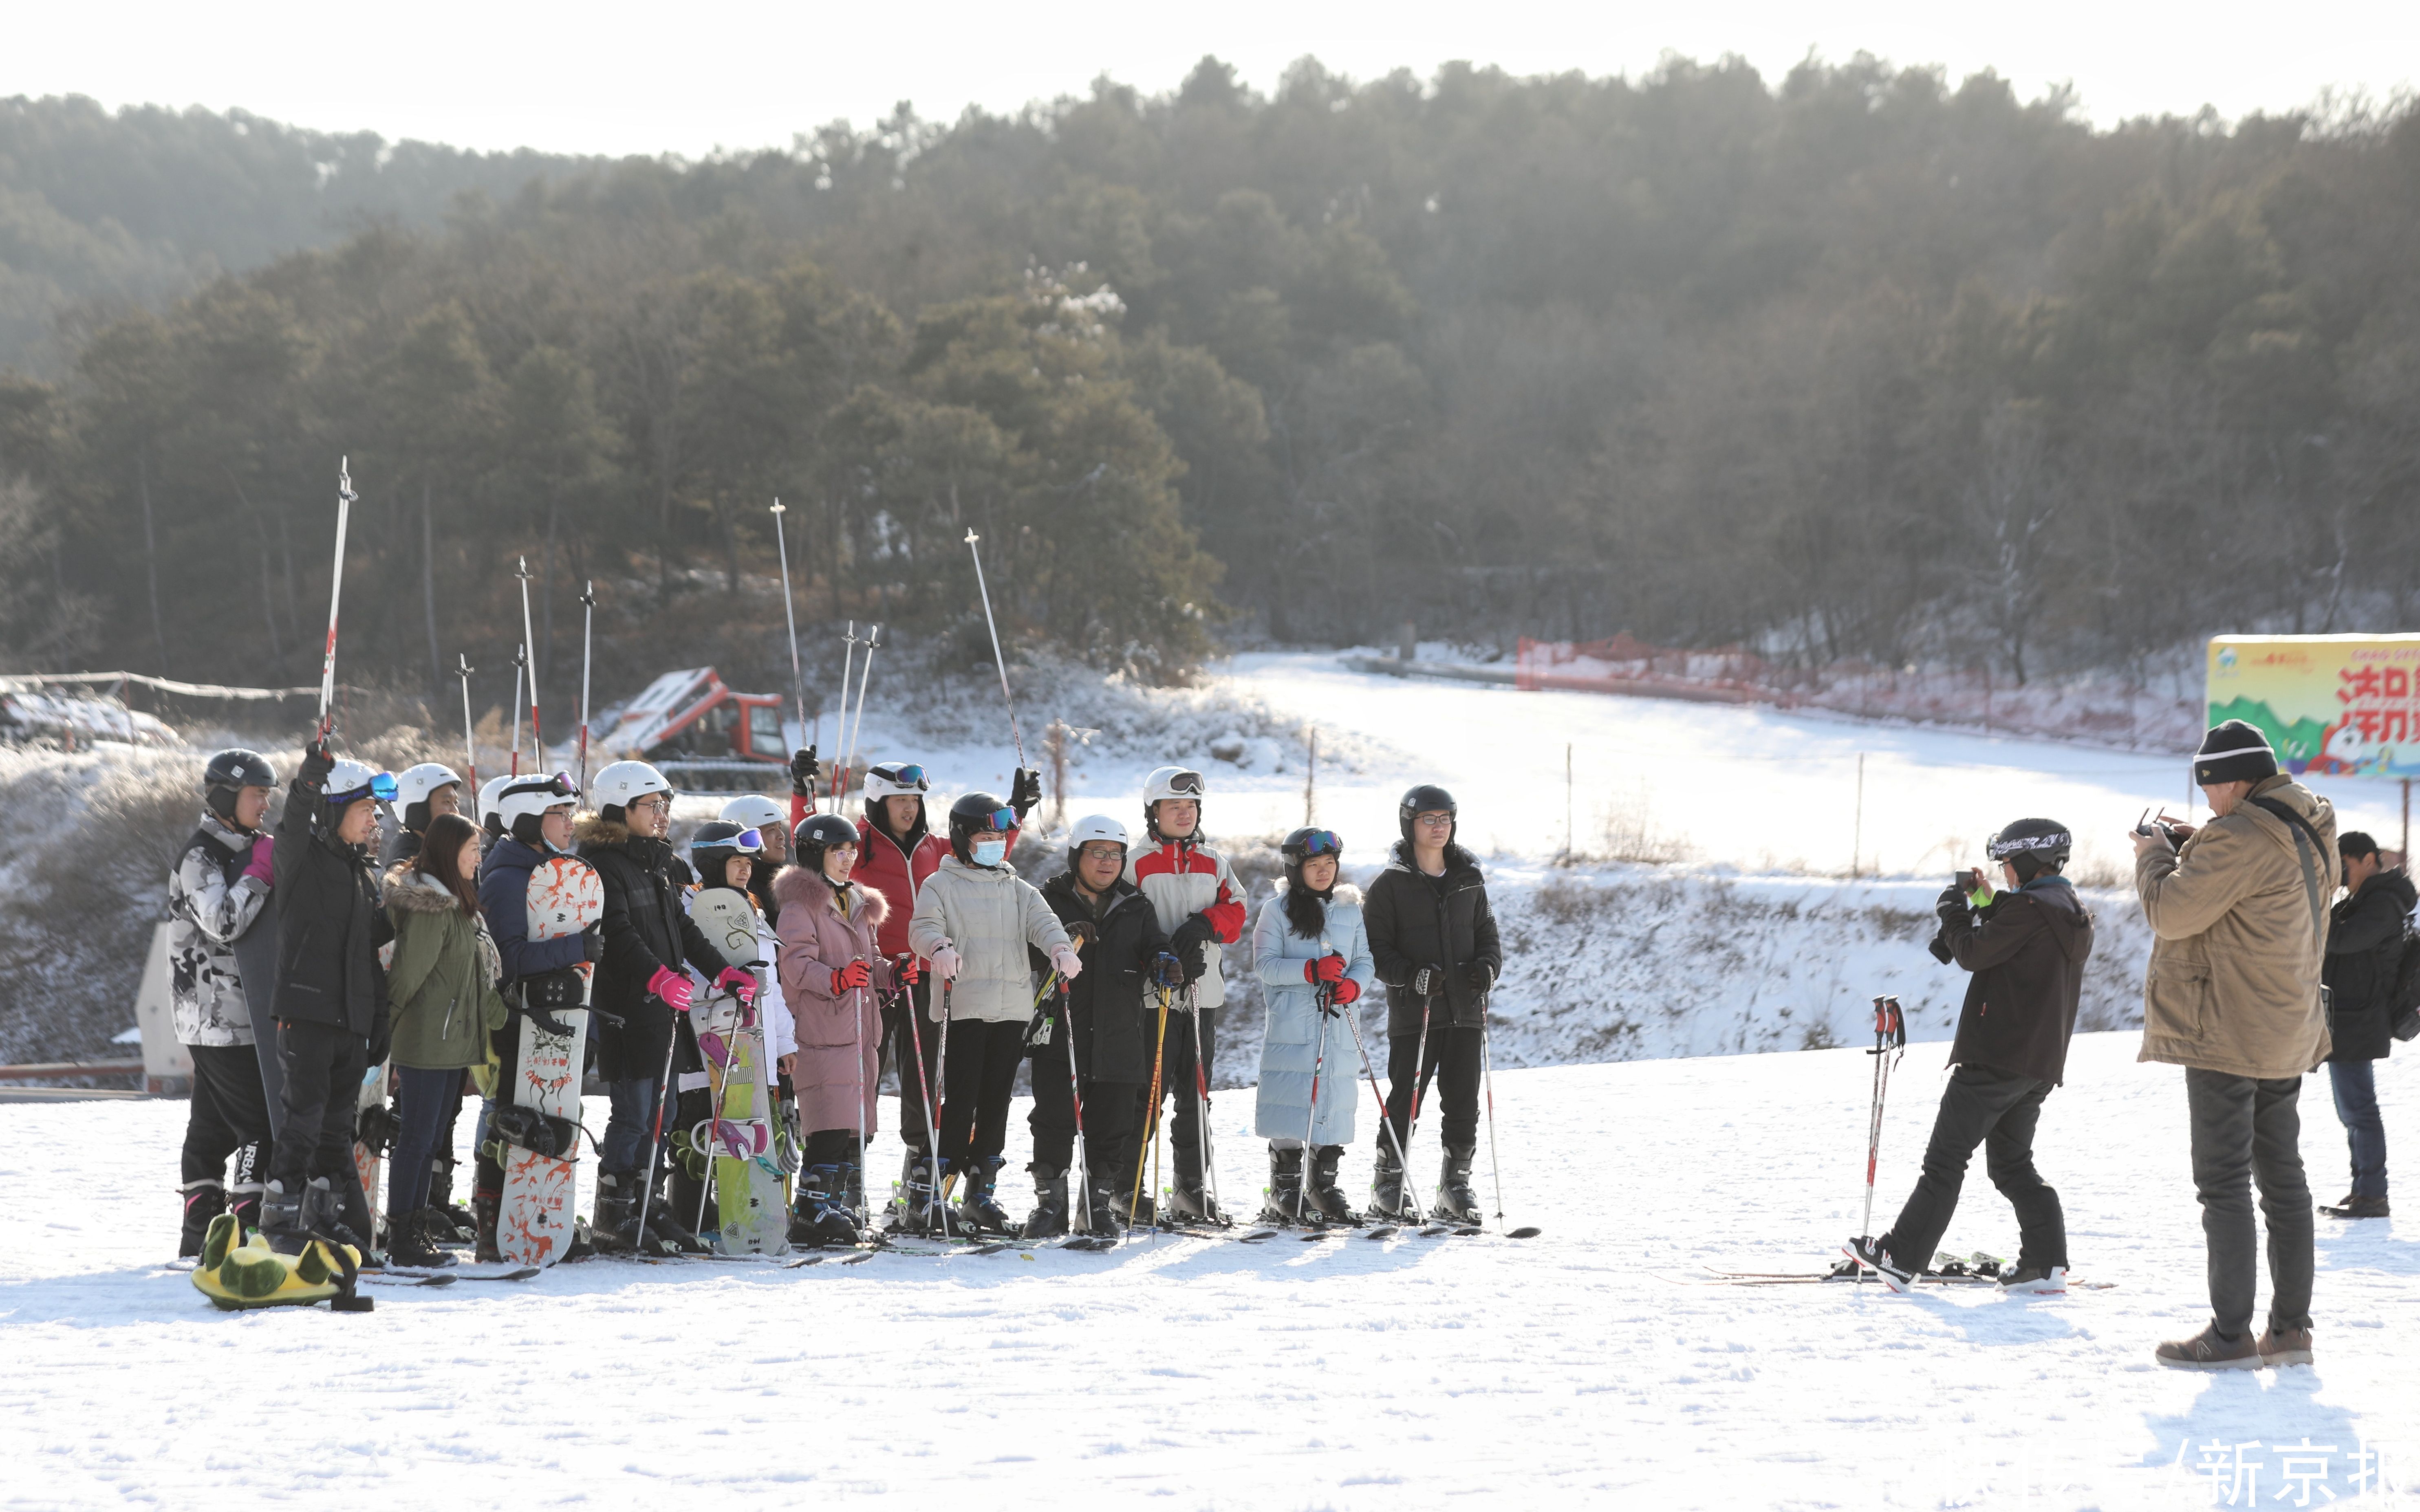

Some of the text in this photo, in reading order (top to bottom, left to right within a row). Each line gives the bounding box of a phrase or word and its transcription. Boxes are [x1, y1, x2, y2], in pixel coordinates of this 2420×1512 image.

[728, 1017, 740, 1058] NORDICA
[1345, 1008, 1362, 1043] NORDICA
[719, 1065, 754, 1085] ISOMNIA
[1879, 1263, 1913, 1279] NORDICA
